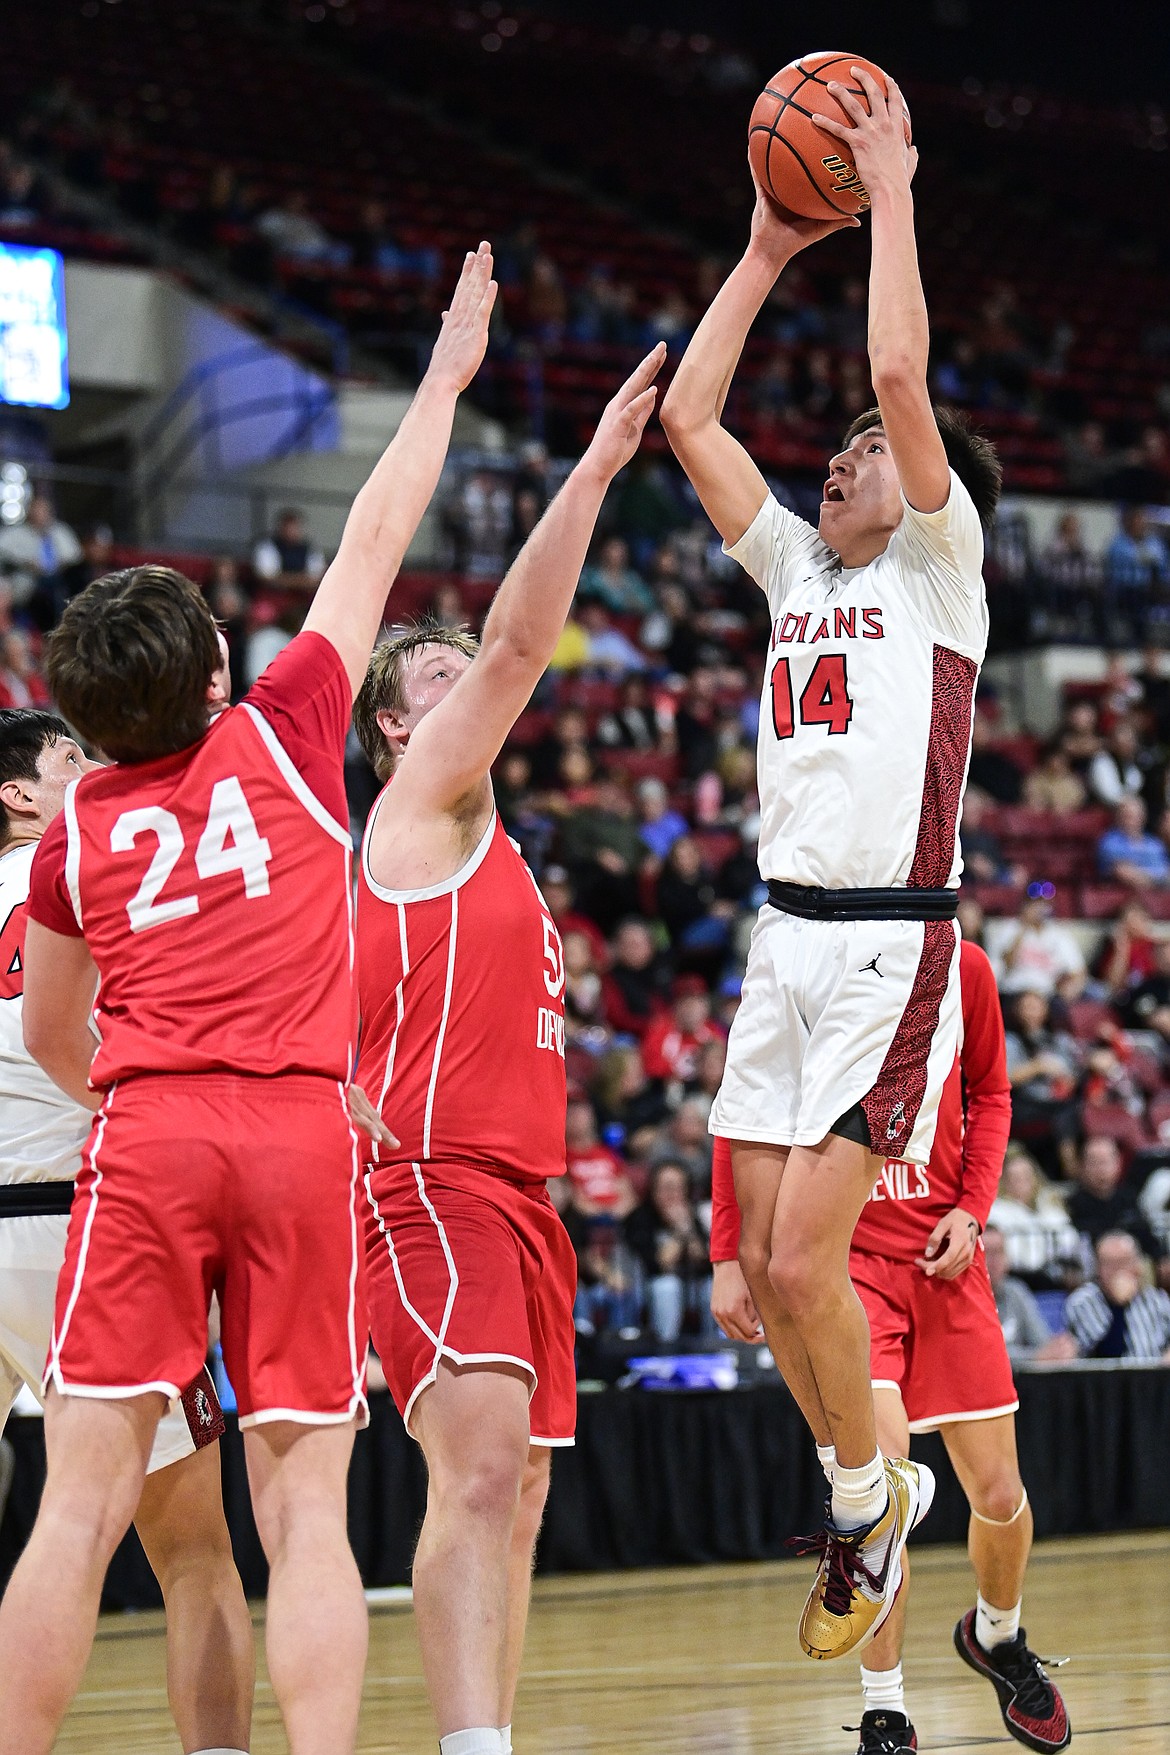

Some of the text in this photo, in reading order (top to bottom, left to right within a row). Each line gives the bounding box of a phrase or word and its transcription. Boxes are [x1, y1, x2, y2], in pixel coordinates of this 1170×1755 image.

[770, 653, 854, 741] 14
[109, 775, 273, 934] 24
[867, 1163, 931, 1202] EVILS
